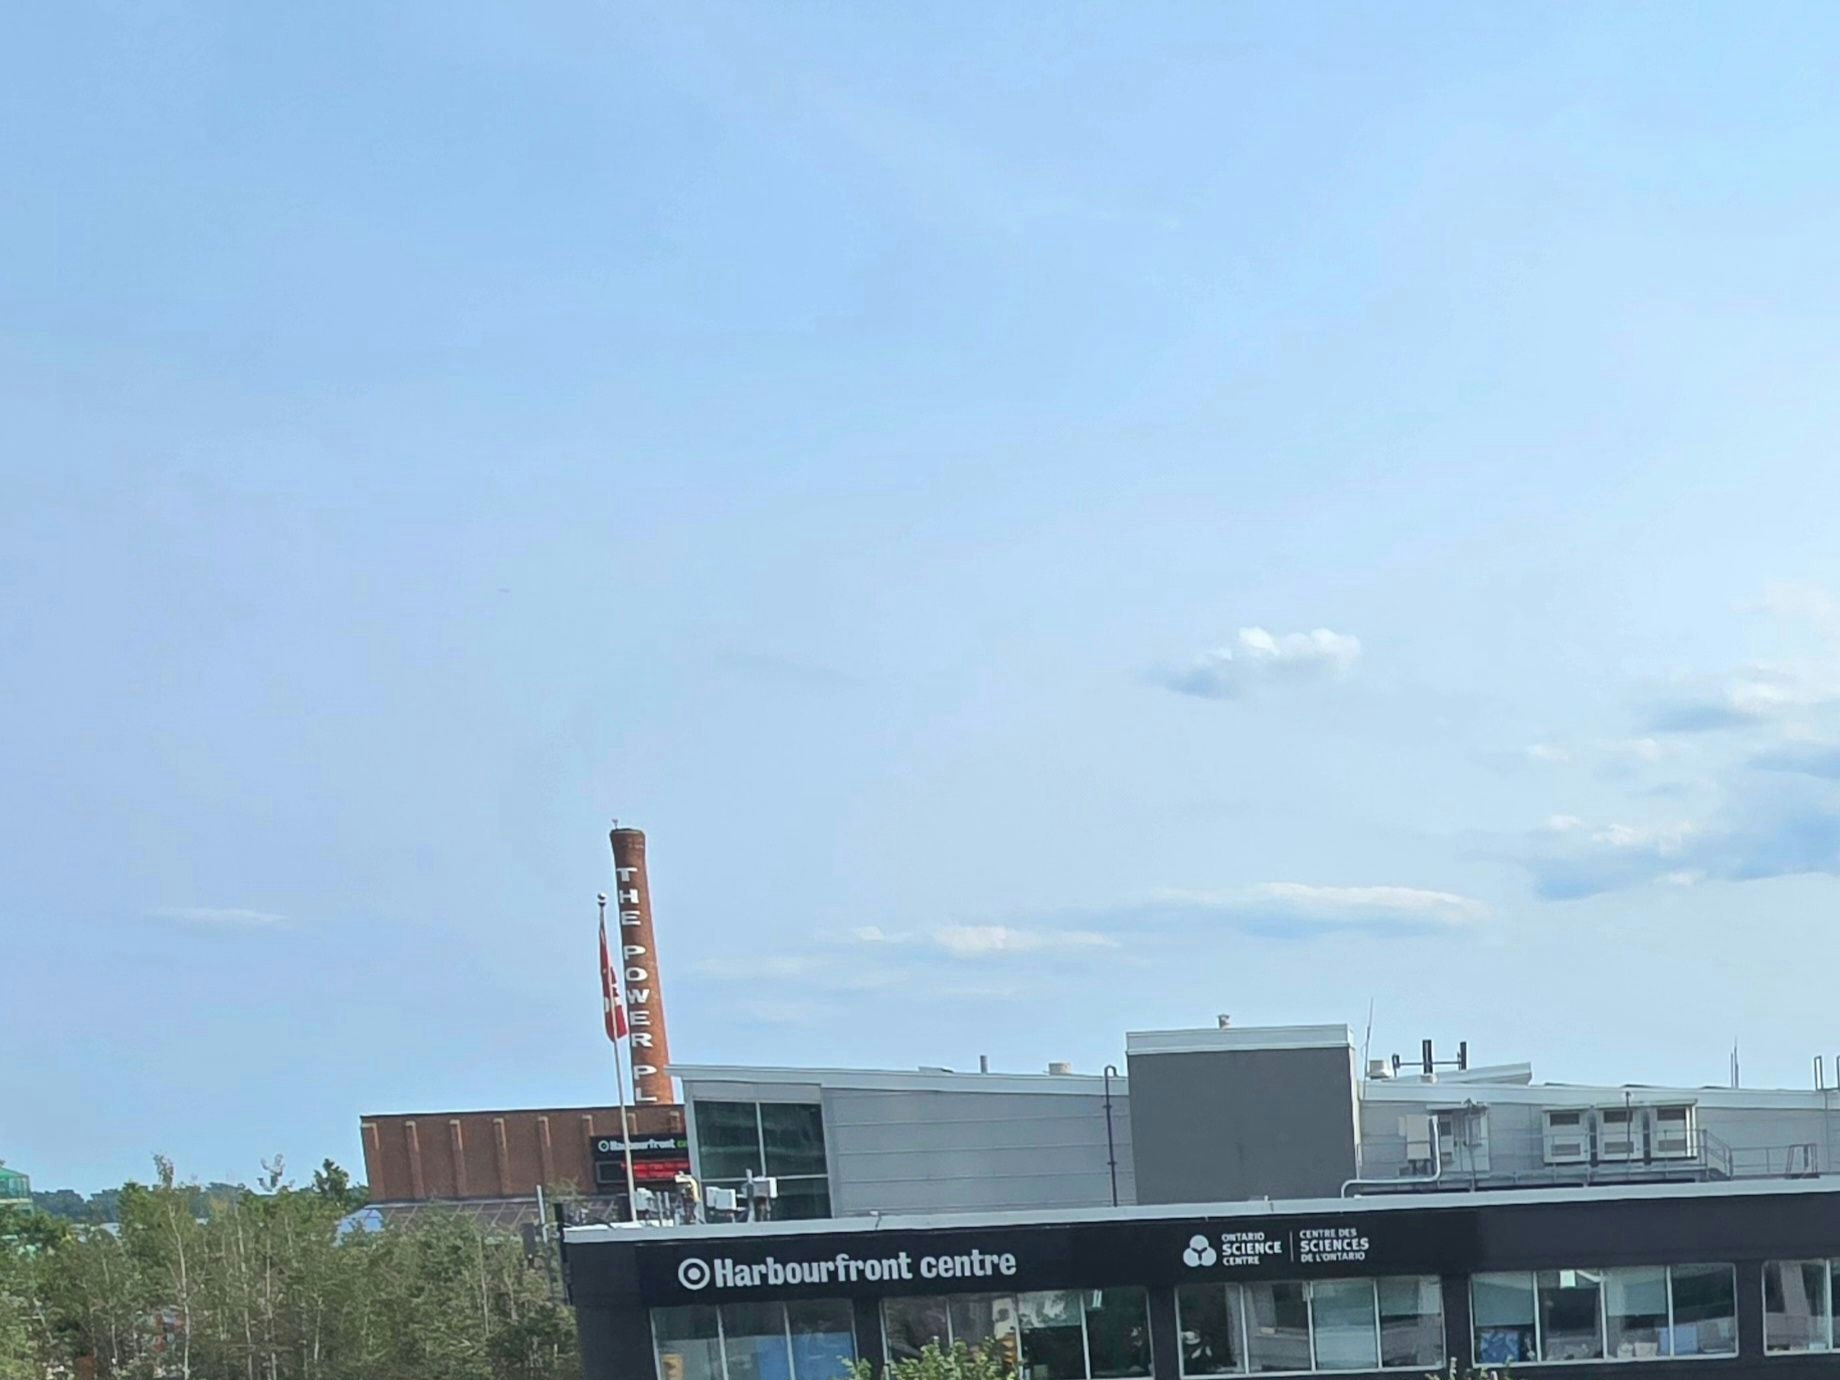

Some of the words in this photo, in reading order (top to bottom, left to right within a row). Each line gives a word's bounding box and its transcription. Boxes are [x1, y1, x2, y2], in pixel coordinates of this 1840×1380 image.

[616, 867, 641, 926] THE
[623, 945, 653, 1048] POWER
[1221, 1232, 1265, 1241] ONTARIO
[1299, 1230, 1336, 1239] CENTRE
[1338, 1228, 1357, 1238] DES
[1222, 1241, 1282, 1255] SCIENCE
[1300, 1237, 1369, 1253] SCIENCES
[1223, 1255, 1260, 1266] CENTRE
[1301, 1253, 1313, 1263] DE
[1316, 1251, 1366, 1262] L'ONTARIO
[713, 1252, 913, 1288] Harbourfront
[920, 1249, 1017, 1278] centre
